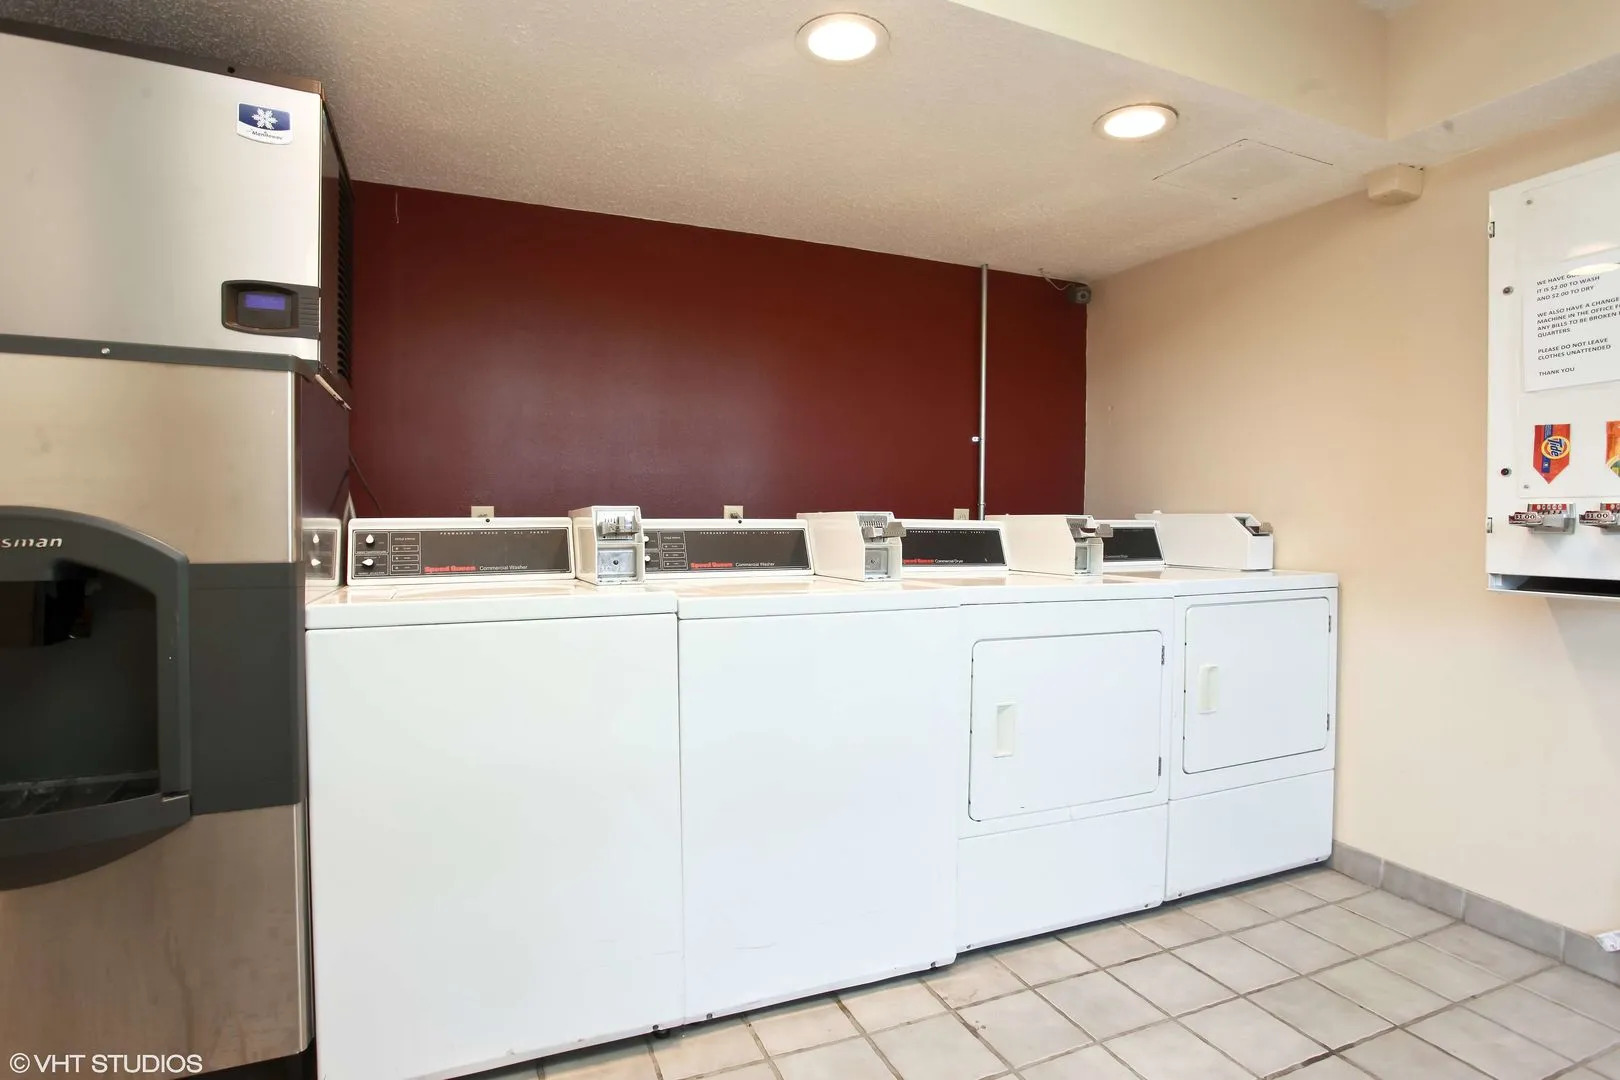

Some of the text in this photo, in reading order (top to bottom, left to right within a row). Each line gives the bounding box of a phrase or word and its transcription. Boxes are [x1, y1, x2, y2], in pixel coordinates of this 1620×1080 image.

[1547, 275, 1565, 283] HAVE
[1580, 276, 1600, 284] WASH
[1566, 304, 1583, 312] HAVE
[1591, 297, 1619, 306] CHANGE
[1537, 315, 1566, 324] MACHINE
[1590, 305, 1613, 314] OFFICE
[1551, 321, 1568, 329] BILLS
[1588, 311, 1617, 321] BROKEN
[1537, 346, 1560, 354] PLEASE
[1587, 338, 1608, 346] LEAVE
[1537, 344, 1612, 361] CLOTHES UNATTENDED
[1548, 437, 1563, 457] Tide
[450, 564, 477, 572] Queen
